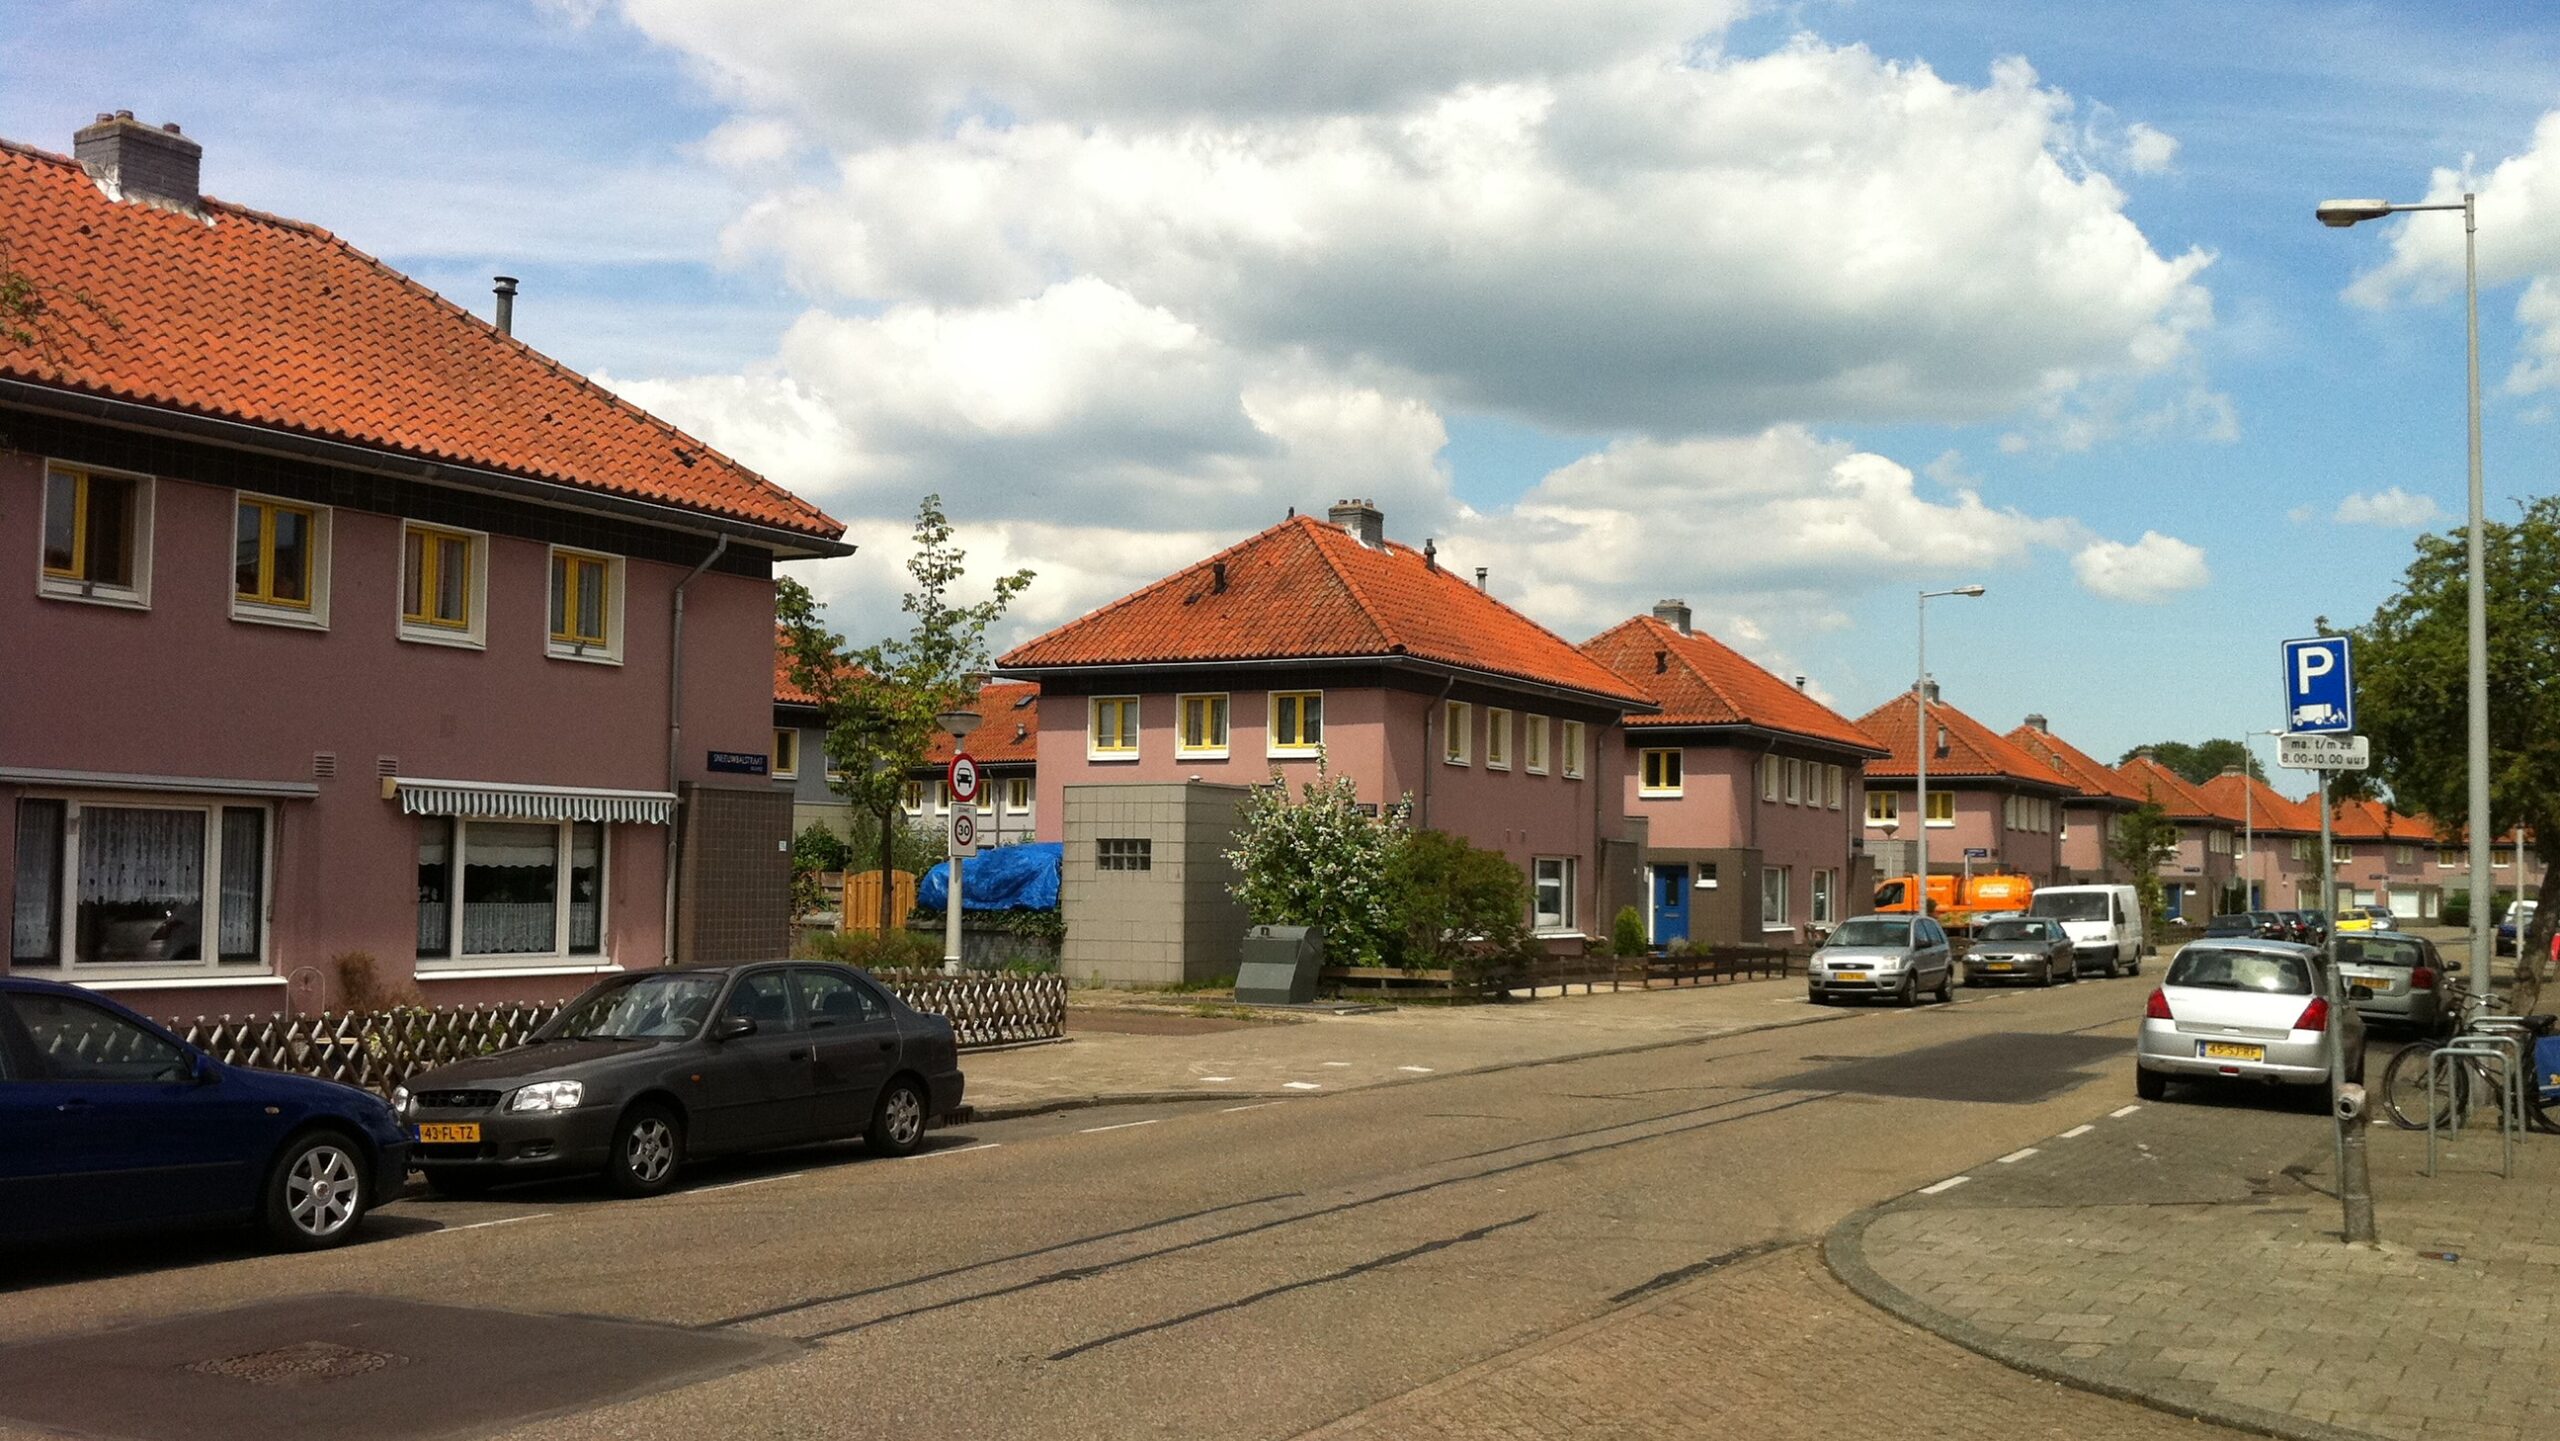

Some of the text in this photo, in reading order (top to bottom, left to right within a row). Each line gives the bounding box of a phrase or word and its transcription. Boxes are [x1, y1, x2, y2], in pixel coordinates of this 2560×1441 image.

[2298, 646, 2335, 695] P
[2291, 740, 2310, 749] ma.
[2315, 738, 2336, 749] t/m
[2346, 756, 2366, 765] uur
[958, 824, 970, 836] 30
